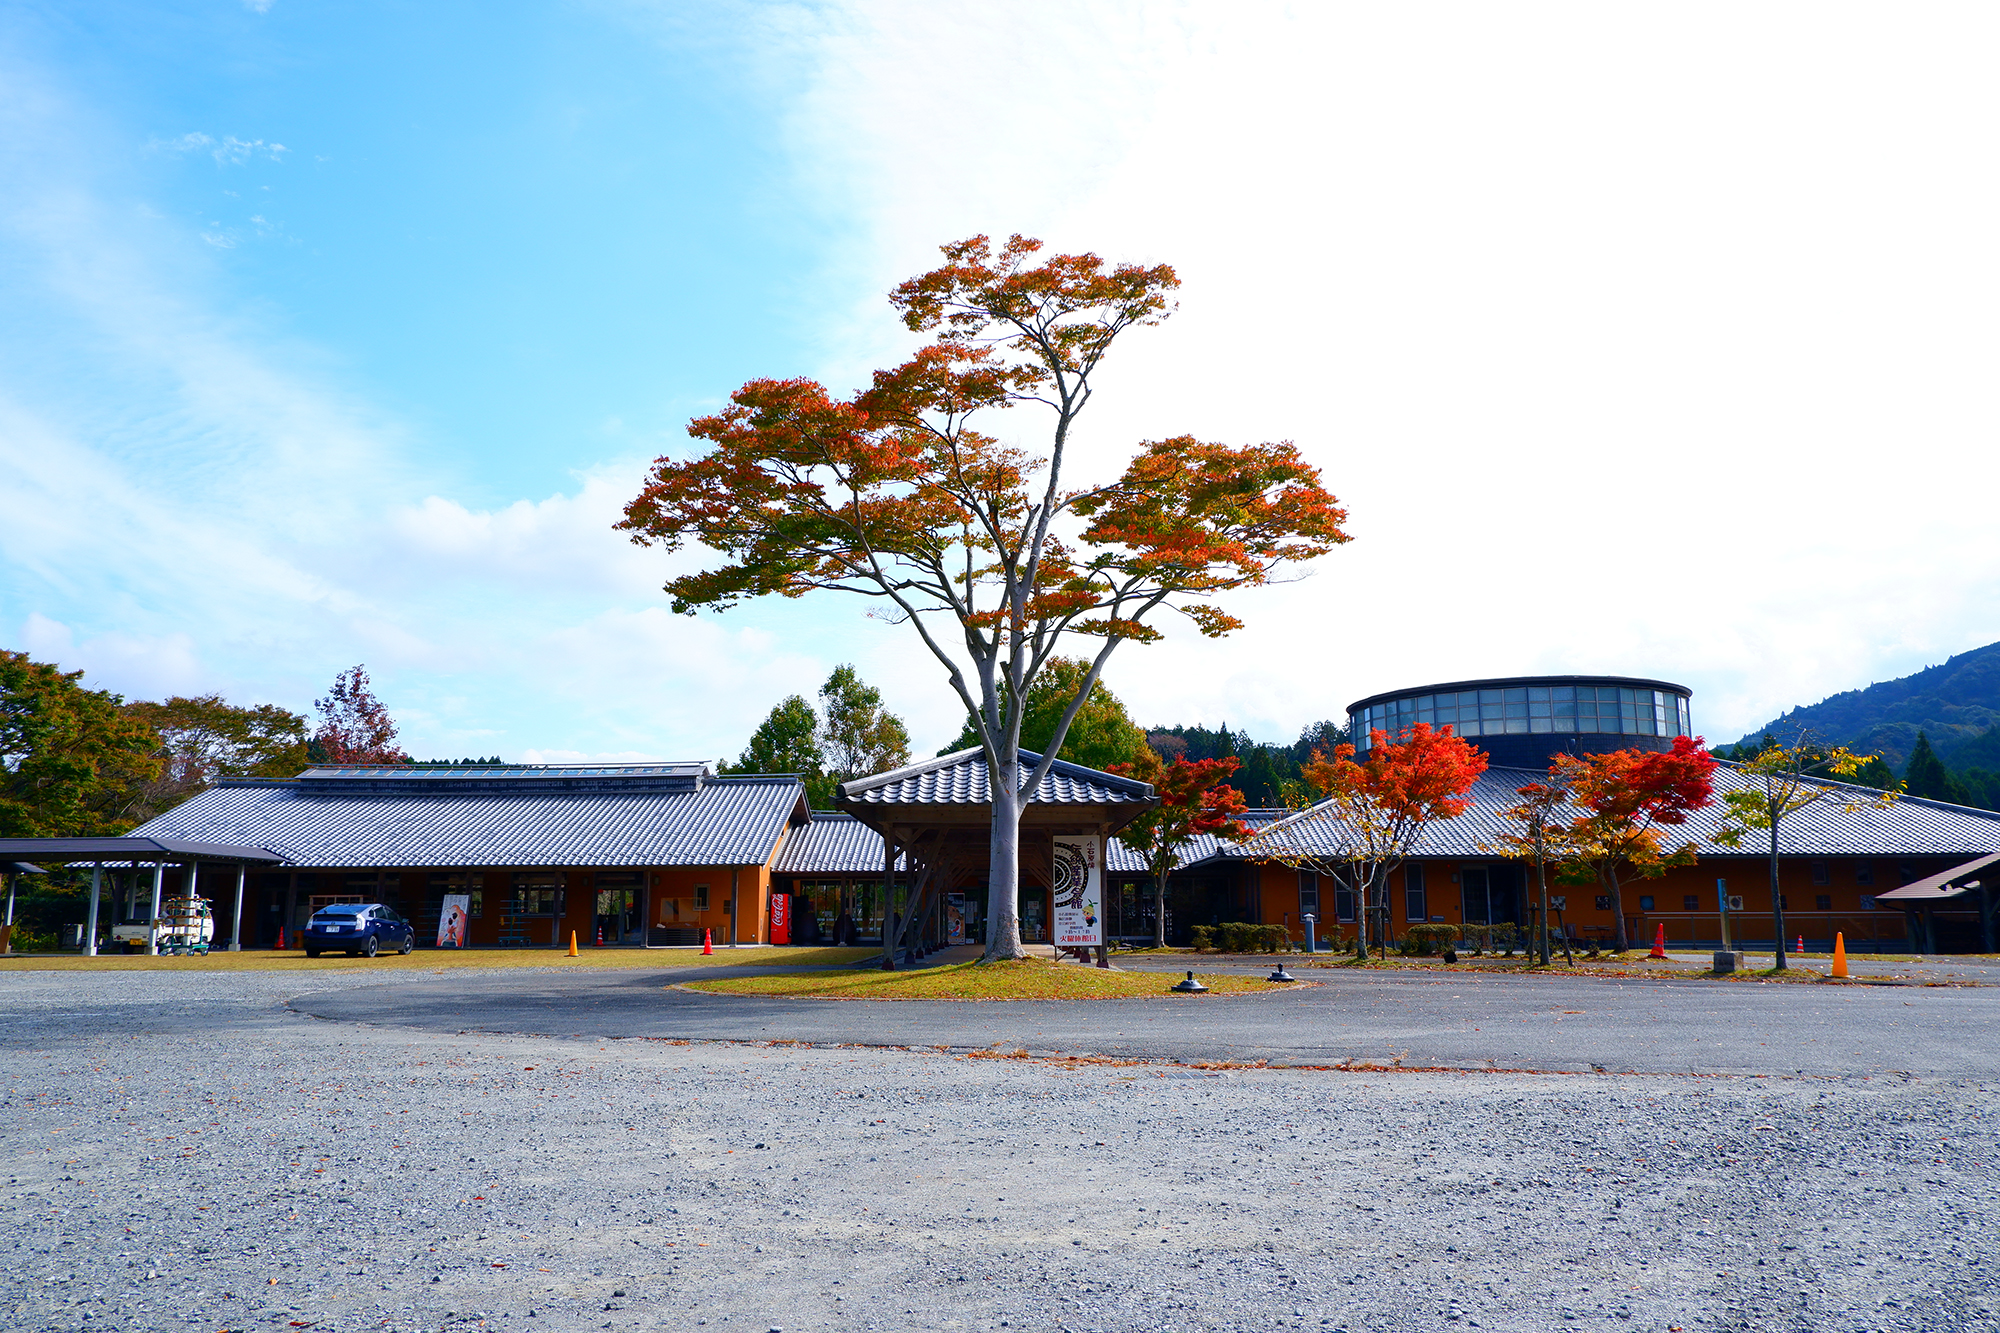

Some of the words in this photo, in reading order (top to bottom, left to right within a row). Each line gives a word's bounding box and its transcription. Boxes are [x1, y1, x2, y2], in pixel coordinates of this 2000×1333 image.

[1059, 934, 1097, 942] 火曜休館日
